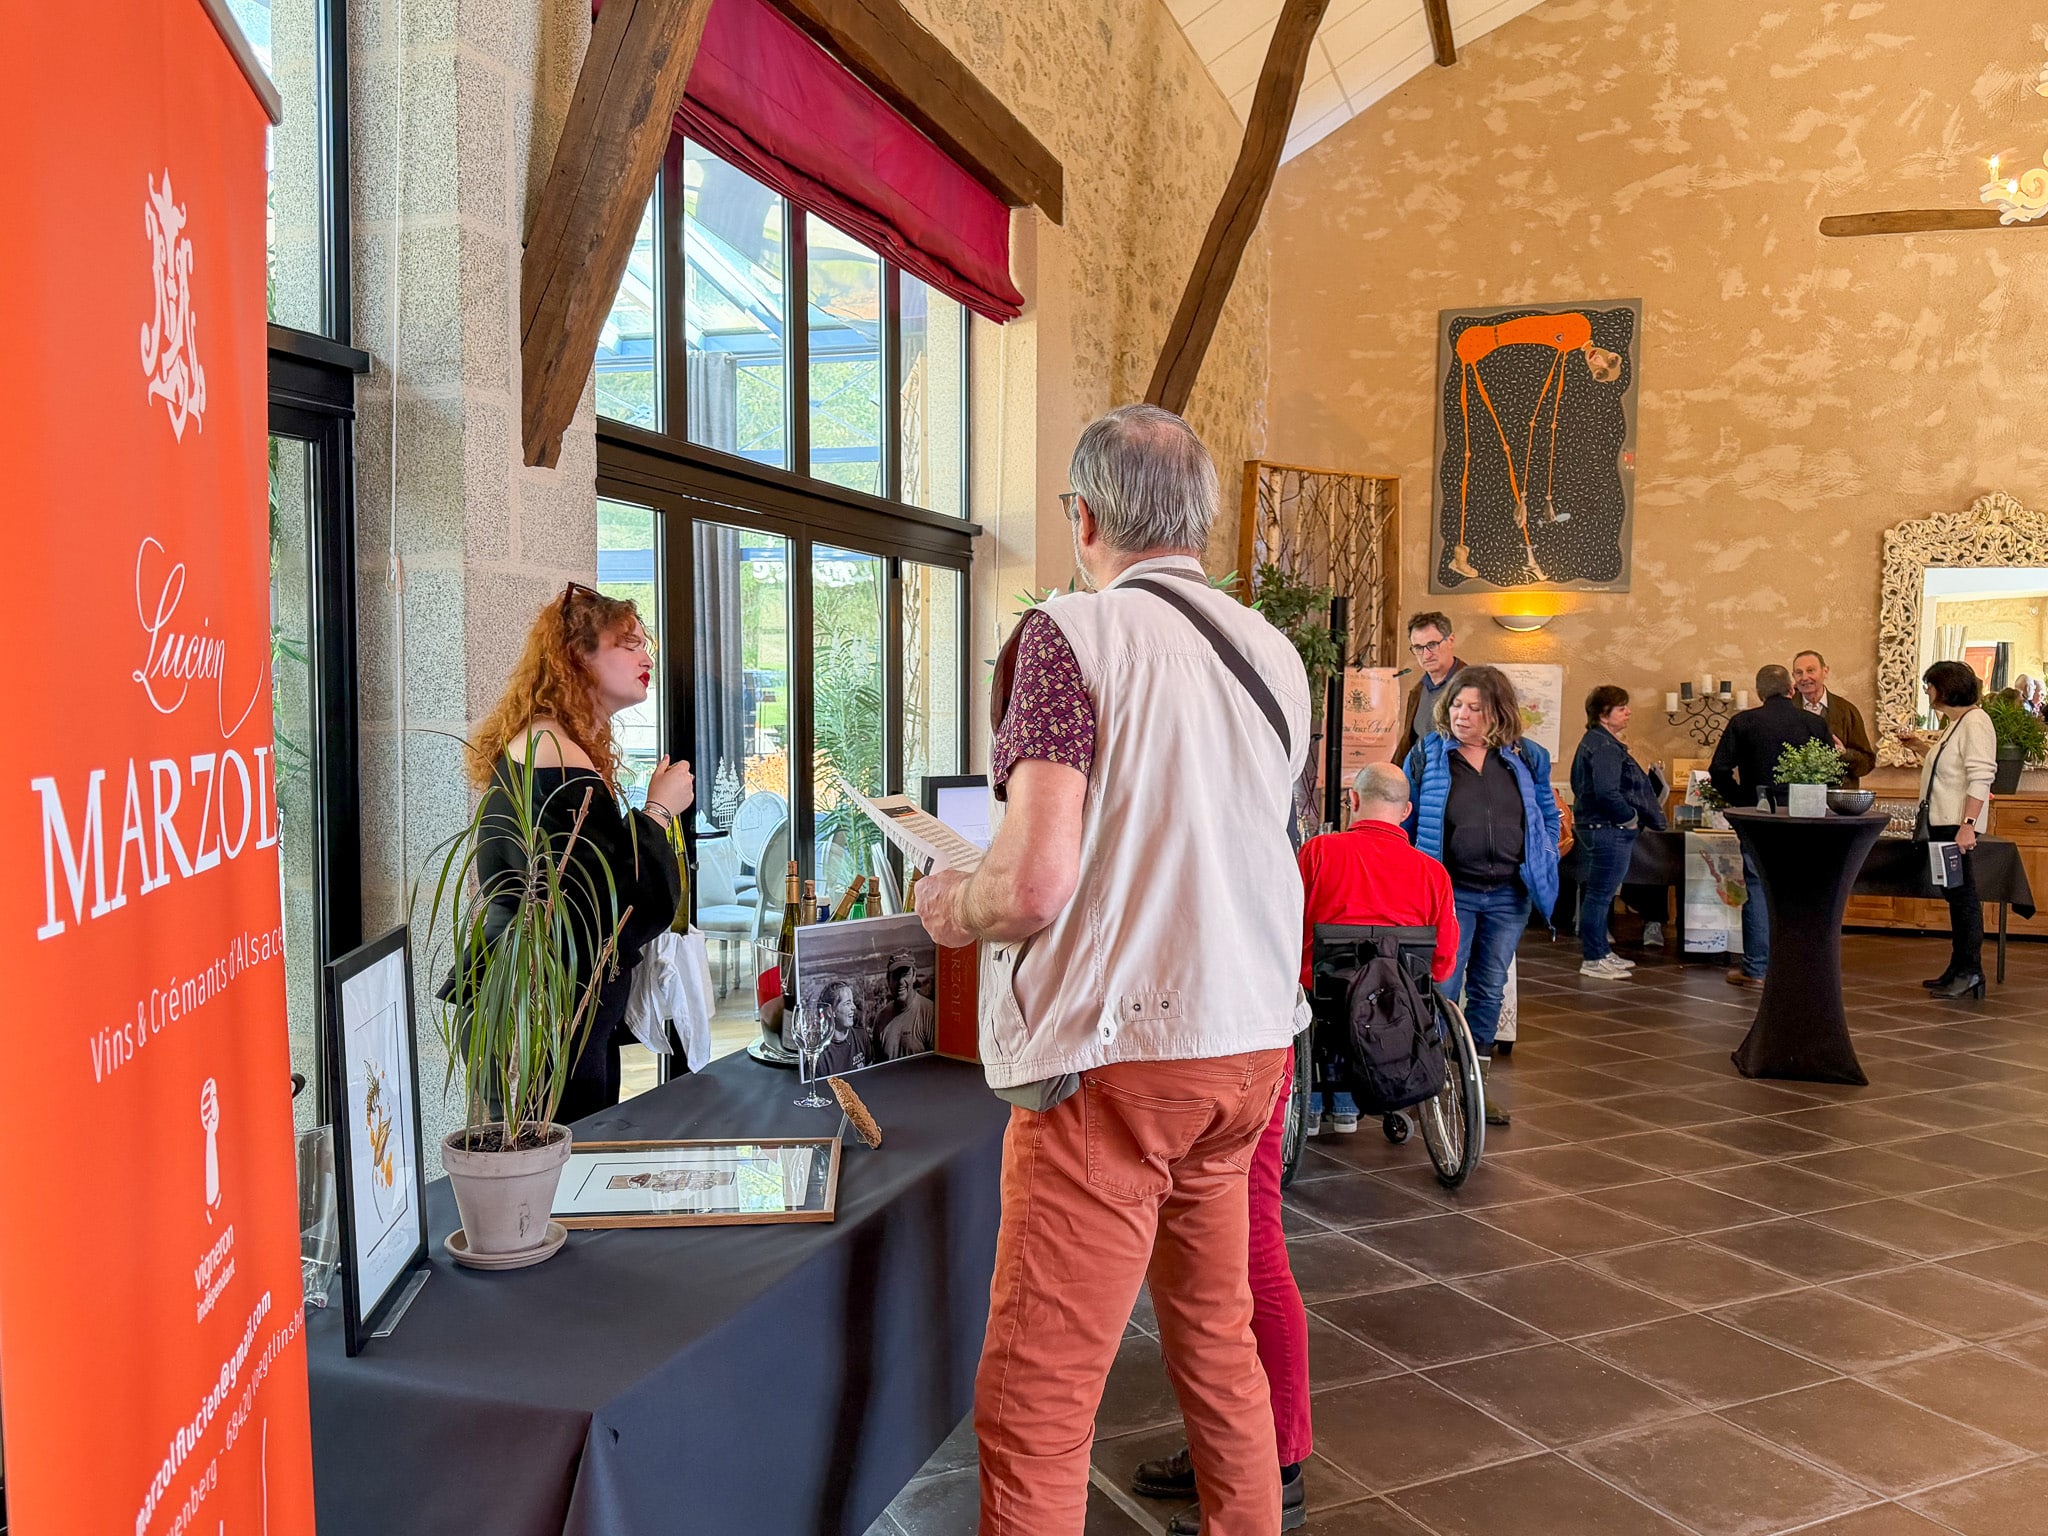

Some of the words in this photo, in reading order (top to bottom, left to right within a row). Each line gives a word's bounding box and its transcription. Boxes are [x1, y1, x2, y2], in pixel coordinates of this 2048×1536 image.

[132, 537, 264, 739] Lucien
[31, 744, 278, 942] MARZOL
[90, 1022, 133, 1084] Vins
[137, 1000, 147, 1048] &
[150, 976, 227, 1035] Crémants
[229, 925, 285, 981] d'Alsace
